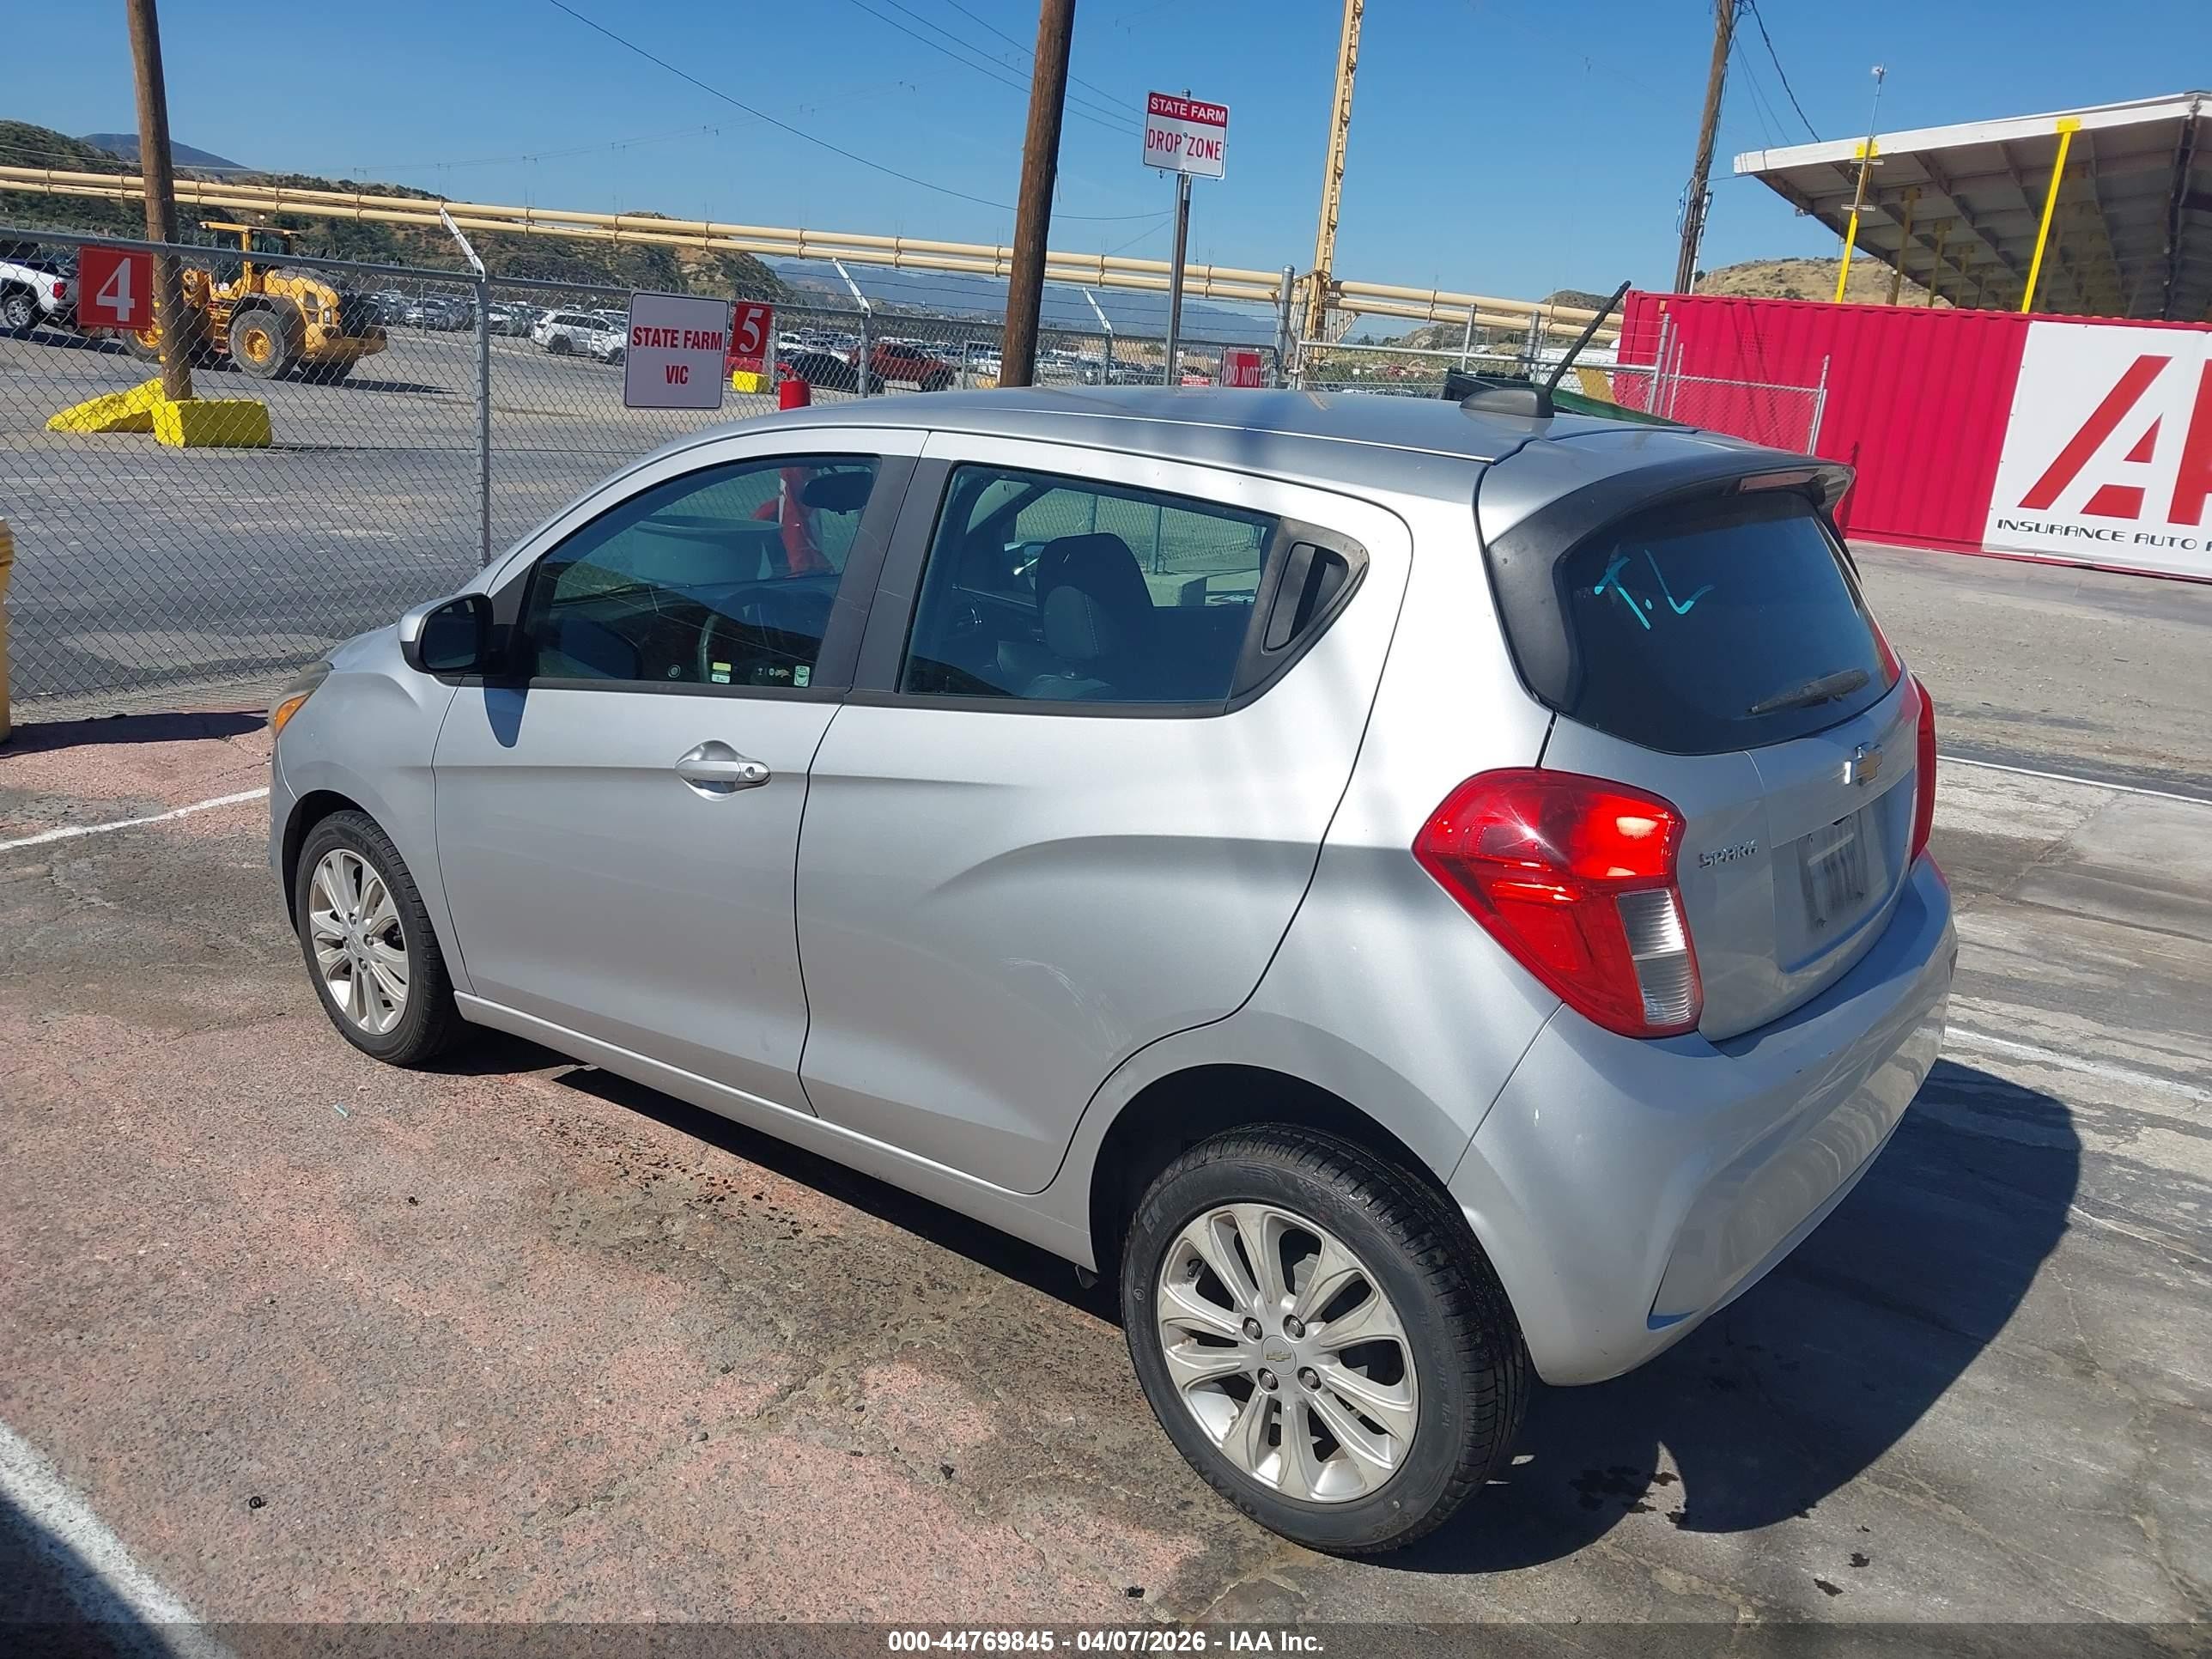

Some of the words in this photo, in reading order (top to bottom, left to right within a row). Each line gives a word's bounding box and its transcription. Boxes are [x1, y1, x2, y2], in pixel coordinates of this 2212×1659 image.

[1151, 97, 1188, 116] STATE
[1191, 105, 1225, 123] FARM
[1147, 128, 1182, 154] DROP
[1187, 137, 1222, 161] ZONE
[96, 258, 135, 322] 4
[633, 326, 678, 349] STATE
[684, 330, 723, 351] FARM
[738, 308, 764, 353] 5
[665, 365, 689, 385] VIC
[1225, 365, 1239, 386] DO
[1241, 366, 1261, 386] NOT
[1996, 519, 2127, 544] INSURANCE
[2133, 532, 2198, 550] AUTO
